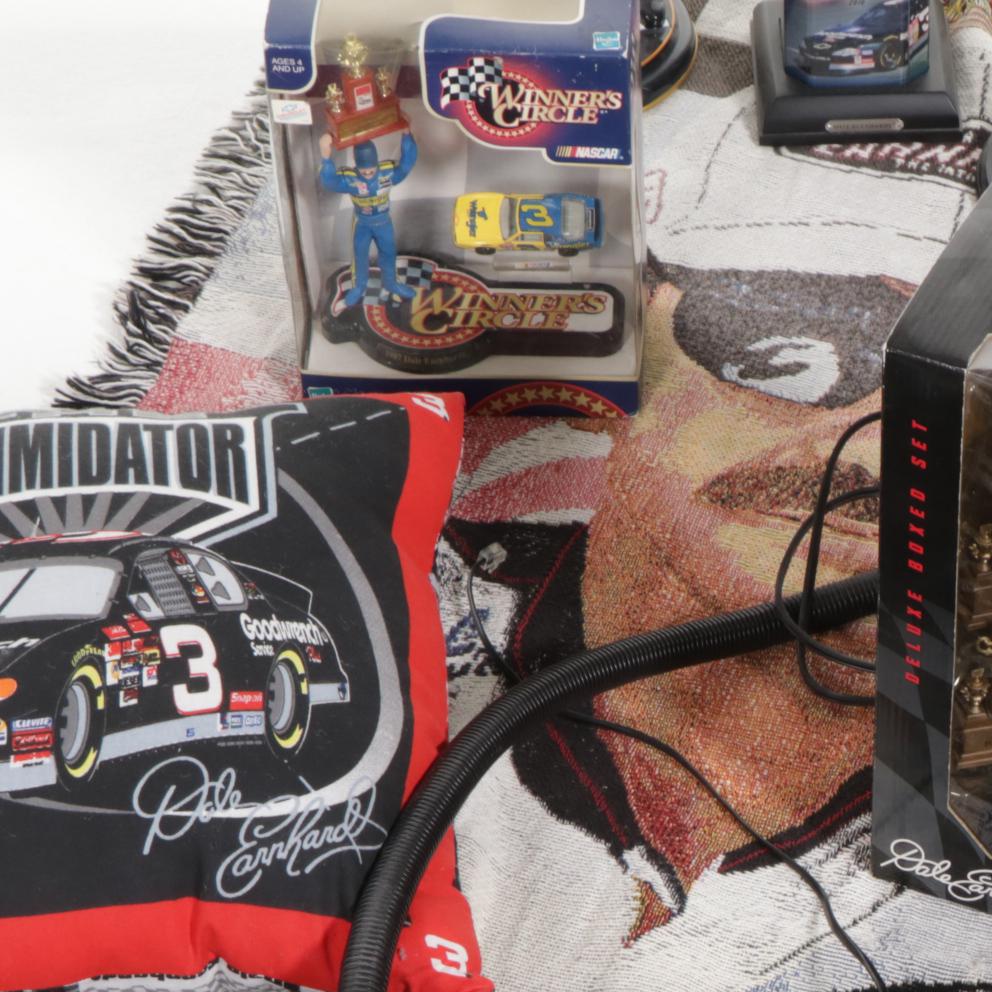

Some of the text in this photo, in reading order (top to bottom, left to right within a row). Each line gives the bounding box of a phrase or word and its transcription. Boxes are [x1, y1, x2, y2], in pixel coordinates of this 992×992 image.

[272, 65, 305, 73] AND UP
[478, 79, 622, 110] WINNER'S
[494, 99, 600, 127] CIRCLE
[574, 145, 620, 160] NASCAR
[521, 204, 553, 227] 3
[413, 286, 608, 315] WINNER'S
[410, 304, 572, 336] CIRCLE
[910, 419, 929, 471] SET
[0, 422, 250, 505] MIDATOR
[907, 488, 927, 573] BOXED
[239, 612, 324, 646] Goodwrench
[904, 590, 924, 685] DELUXE
[160, 624, 223, 716] 3
[880, 838, 952, 889] Dale
[424, 933, 470, 978] 3
